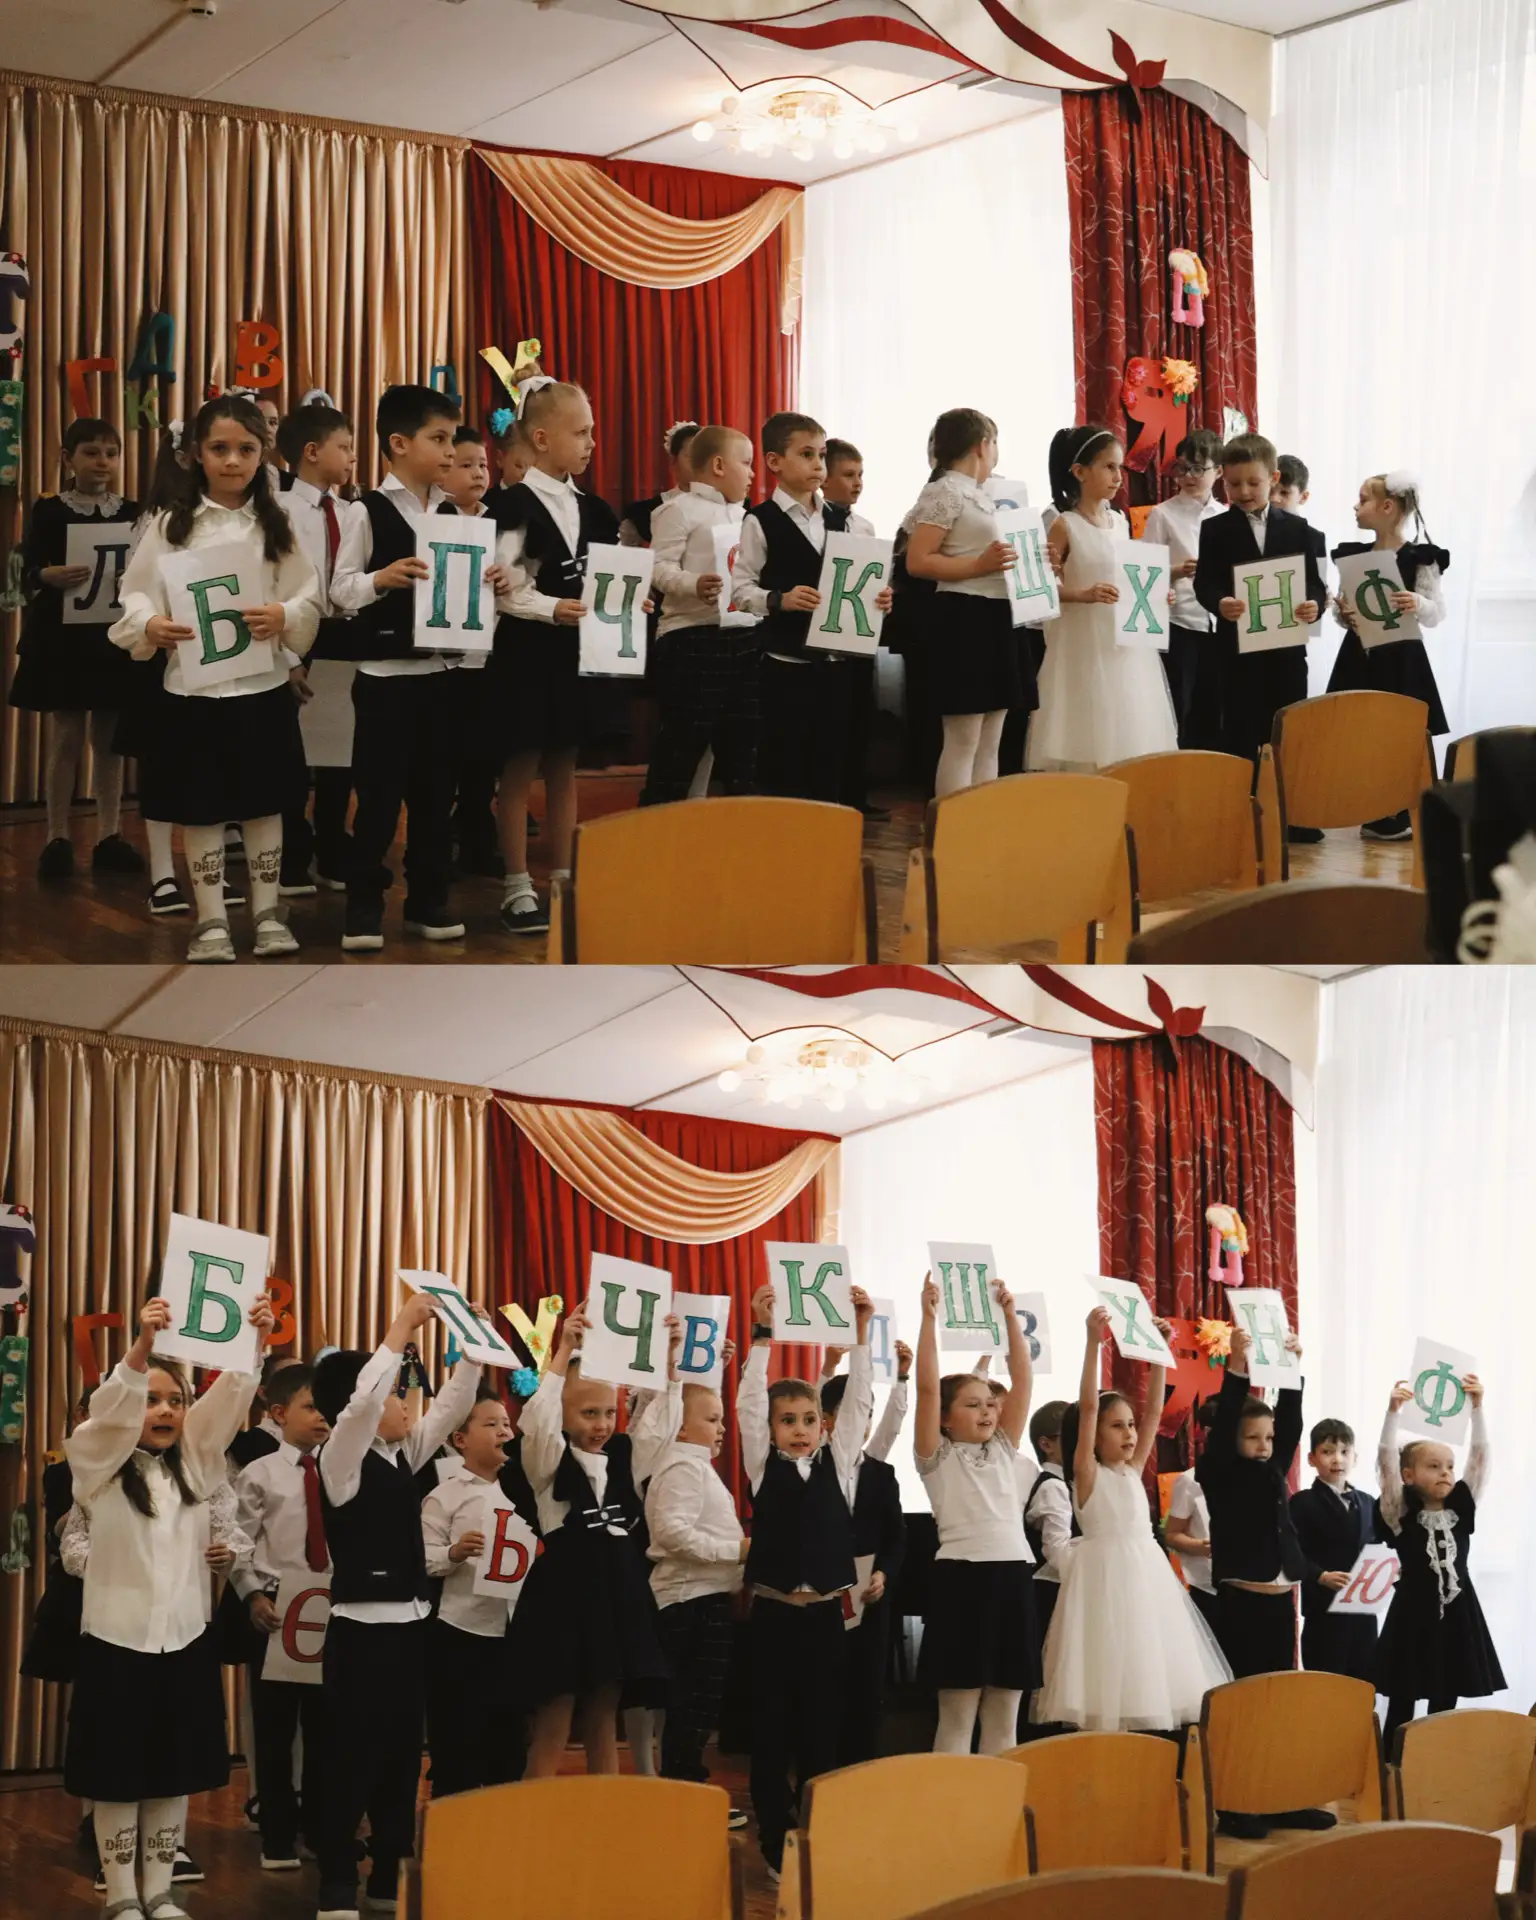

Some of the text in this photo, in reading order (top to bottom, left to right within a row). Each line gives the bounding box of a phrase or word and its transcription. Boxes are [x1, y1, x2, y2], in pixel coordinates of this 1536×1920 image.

[65, 357, 117, 418] Г
[236, 321, 284, 388] В
[124, 386, 163, 430] К
[1123, 357, 1191, 477] Я
[74, 543, 131, 611] Л
[426, 541, 487, 631] П
[819, 557, 884, 637] К
[1005, 528, 1054, 609] Щ
[1123, 563, 1164, 634] Х
[1243, 569, 1299, 633] Н
[1355, 568, 1405, 631] Ф
[186, 573, 252, 665] Б
[594, 572, 643, 658] Ч
[179, 1250, 244, 1343] Б
[419, 1285, 506, 1351] П
[600, 1281, 661, 1373] Ч
[779, 1260, 849, 1328] К
[938, 1261, 1000, 1345] Щ
[1101, 1291, 1165, 1352] Х
[72, 1312, 124, 1390] Г
[677, 1315, 718, 1374] В
[1239, 1303, 1293, 1367] Н
[1414, 1360, 1466, 1427] Ф
[1339, 1557, 1399, 1604] Ю
